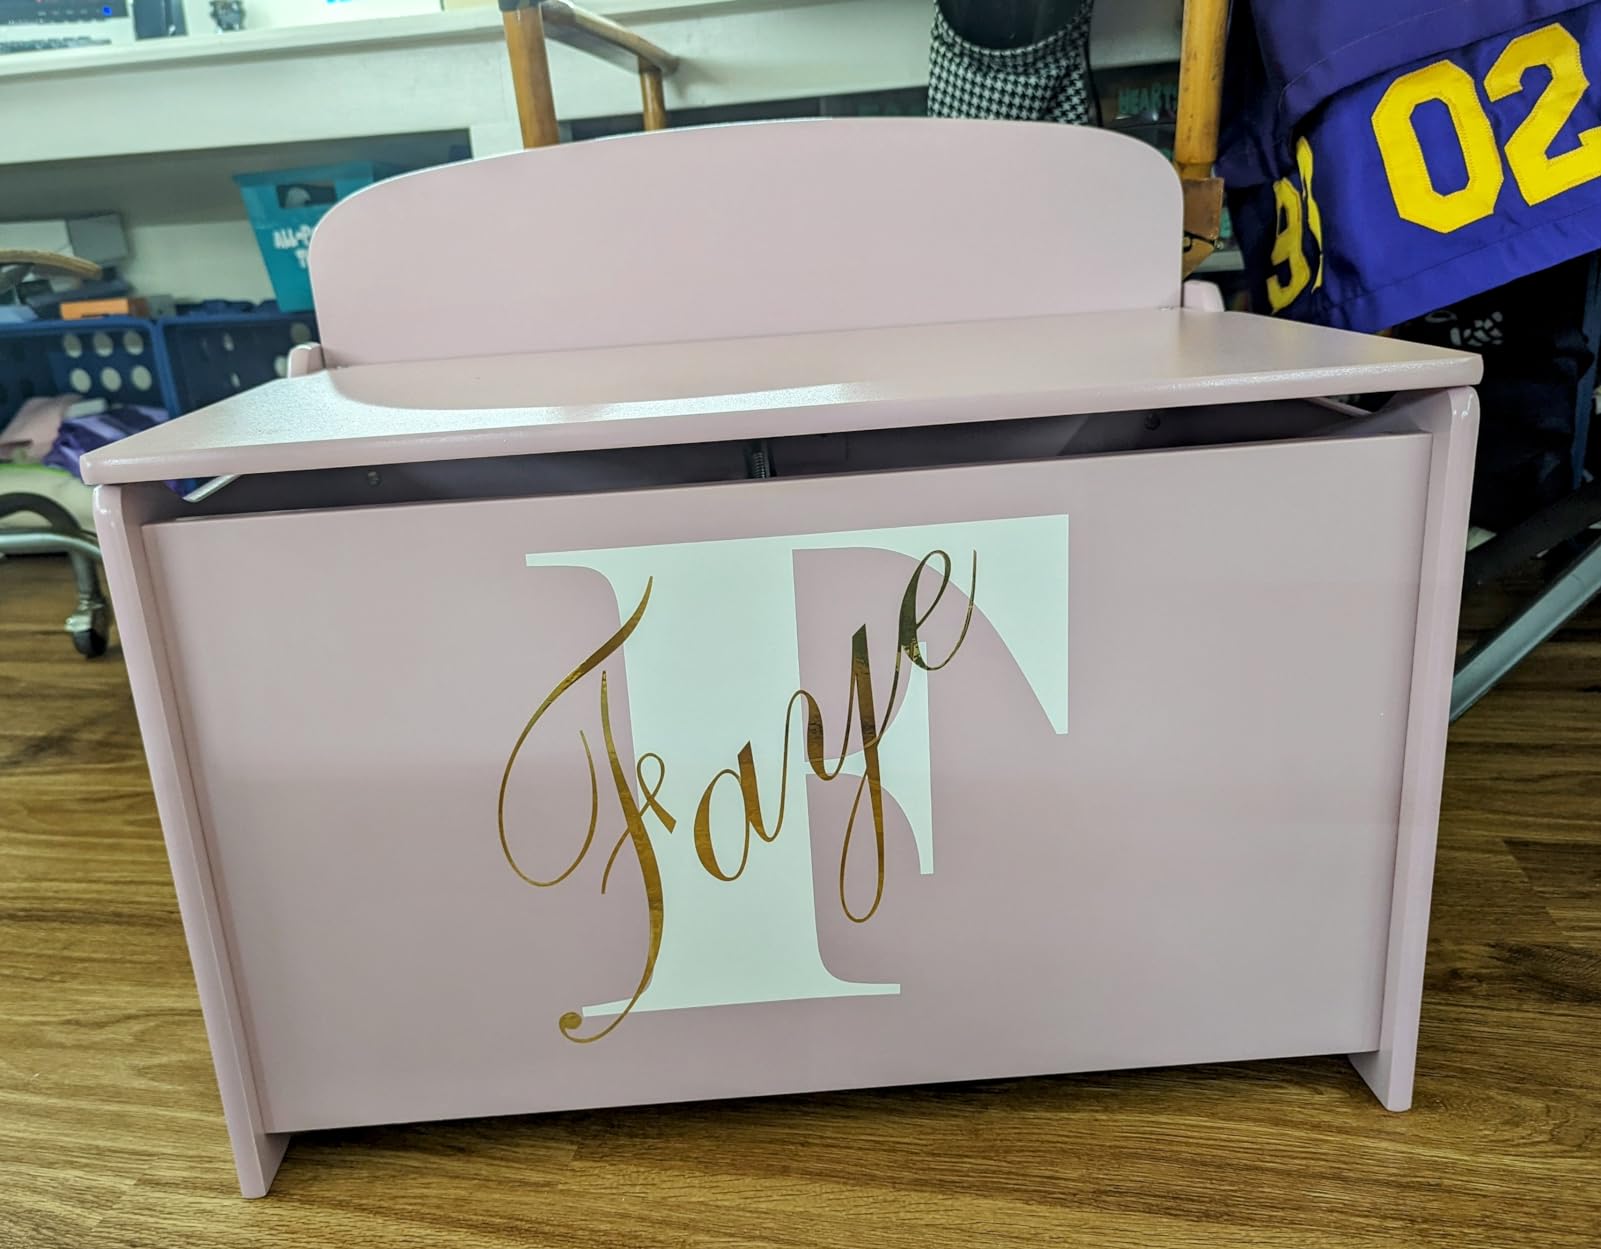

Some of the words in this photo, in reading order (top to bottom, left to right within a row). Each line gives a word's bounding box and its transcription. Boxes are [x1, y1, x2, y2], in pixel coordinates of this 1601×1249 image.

[1371, 23, 1601, 234] 02
[499, 549, 977, 1043] Faye
[525, 513, 1070, 1018] F
